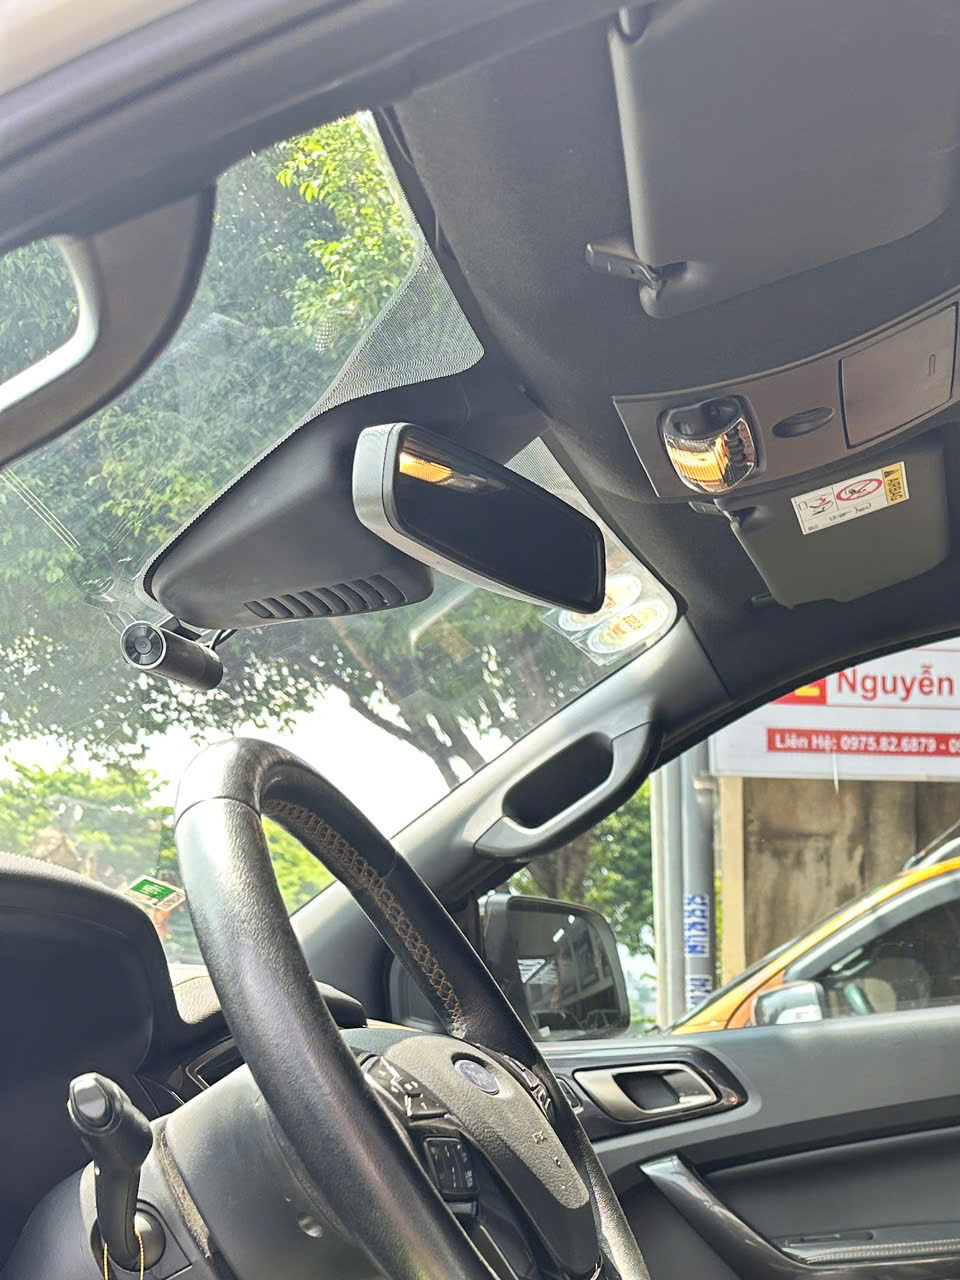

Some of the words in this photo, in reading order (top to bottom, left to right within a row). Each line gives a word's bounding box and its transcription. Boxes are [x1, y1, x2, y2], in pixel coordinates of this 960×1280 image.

[836, 664, 954, 702] Nguyễn
[774, 733, 809, 750] Liên
[811, 734, 837, 754] Hệ:
